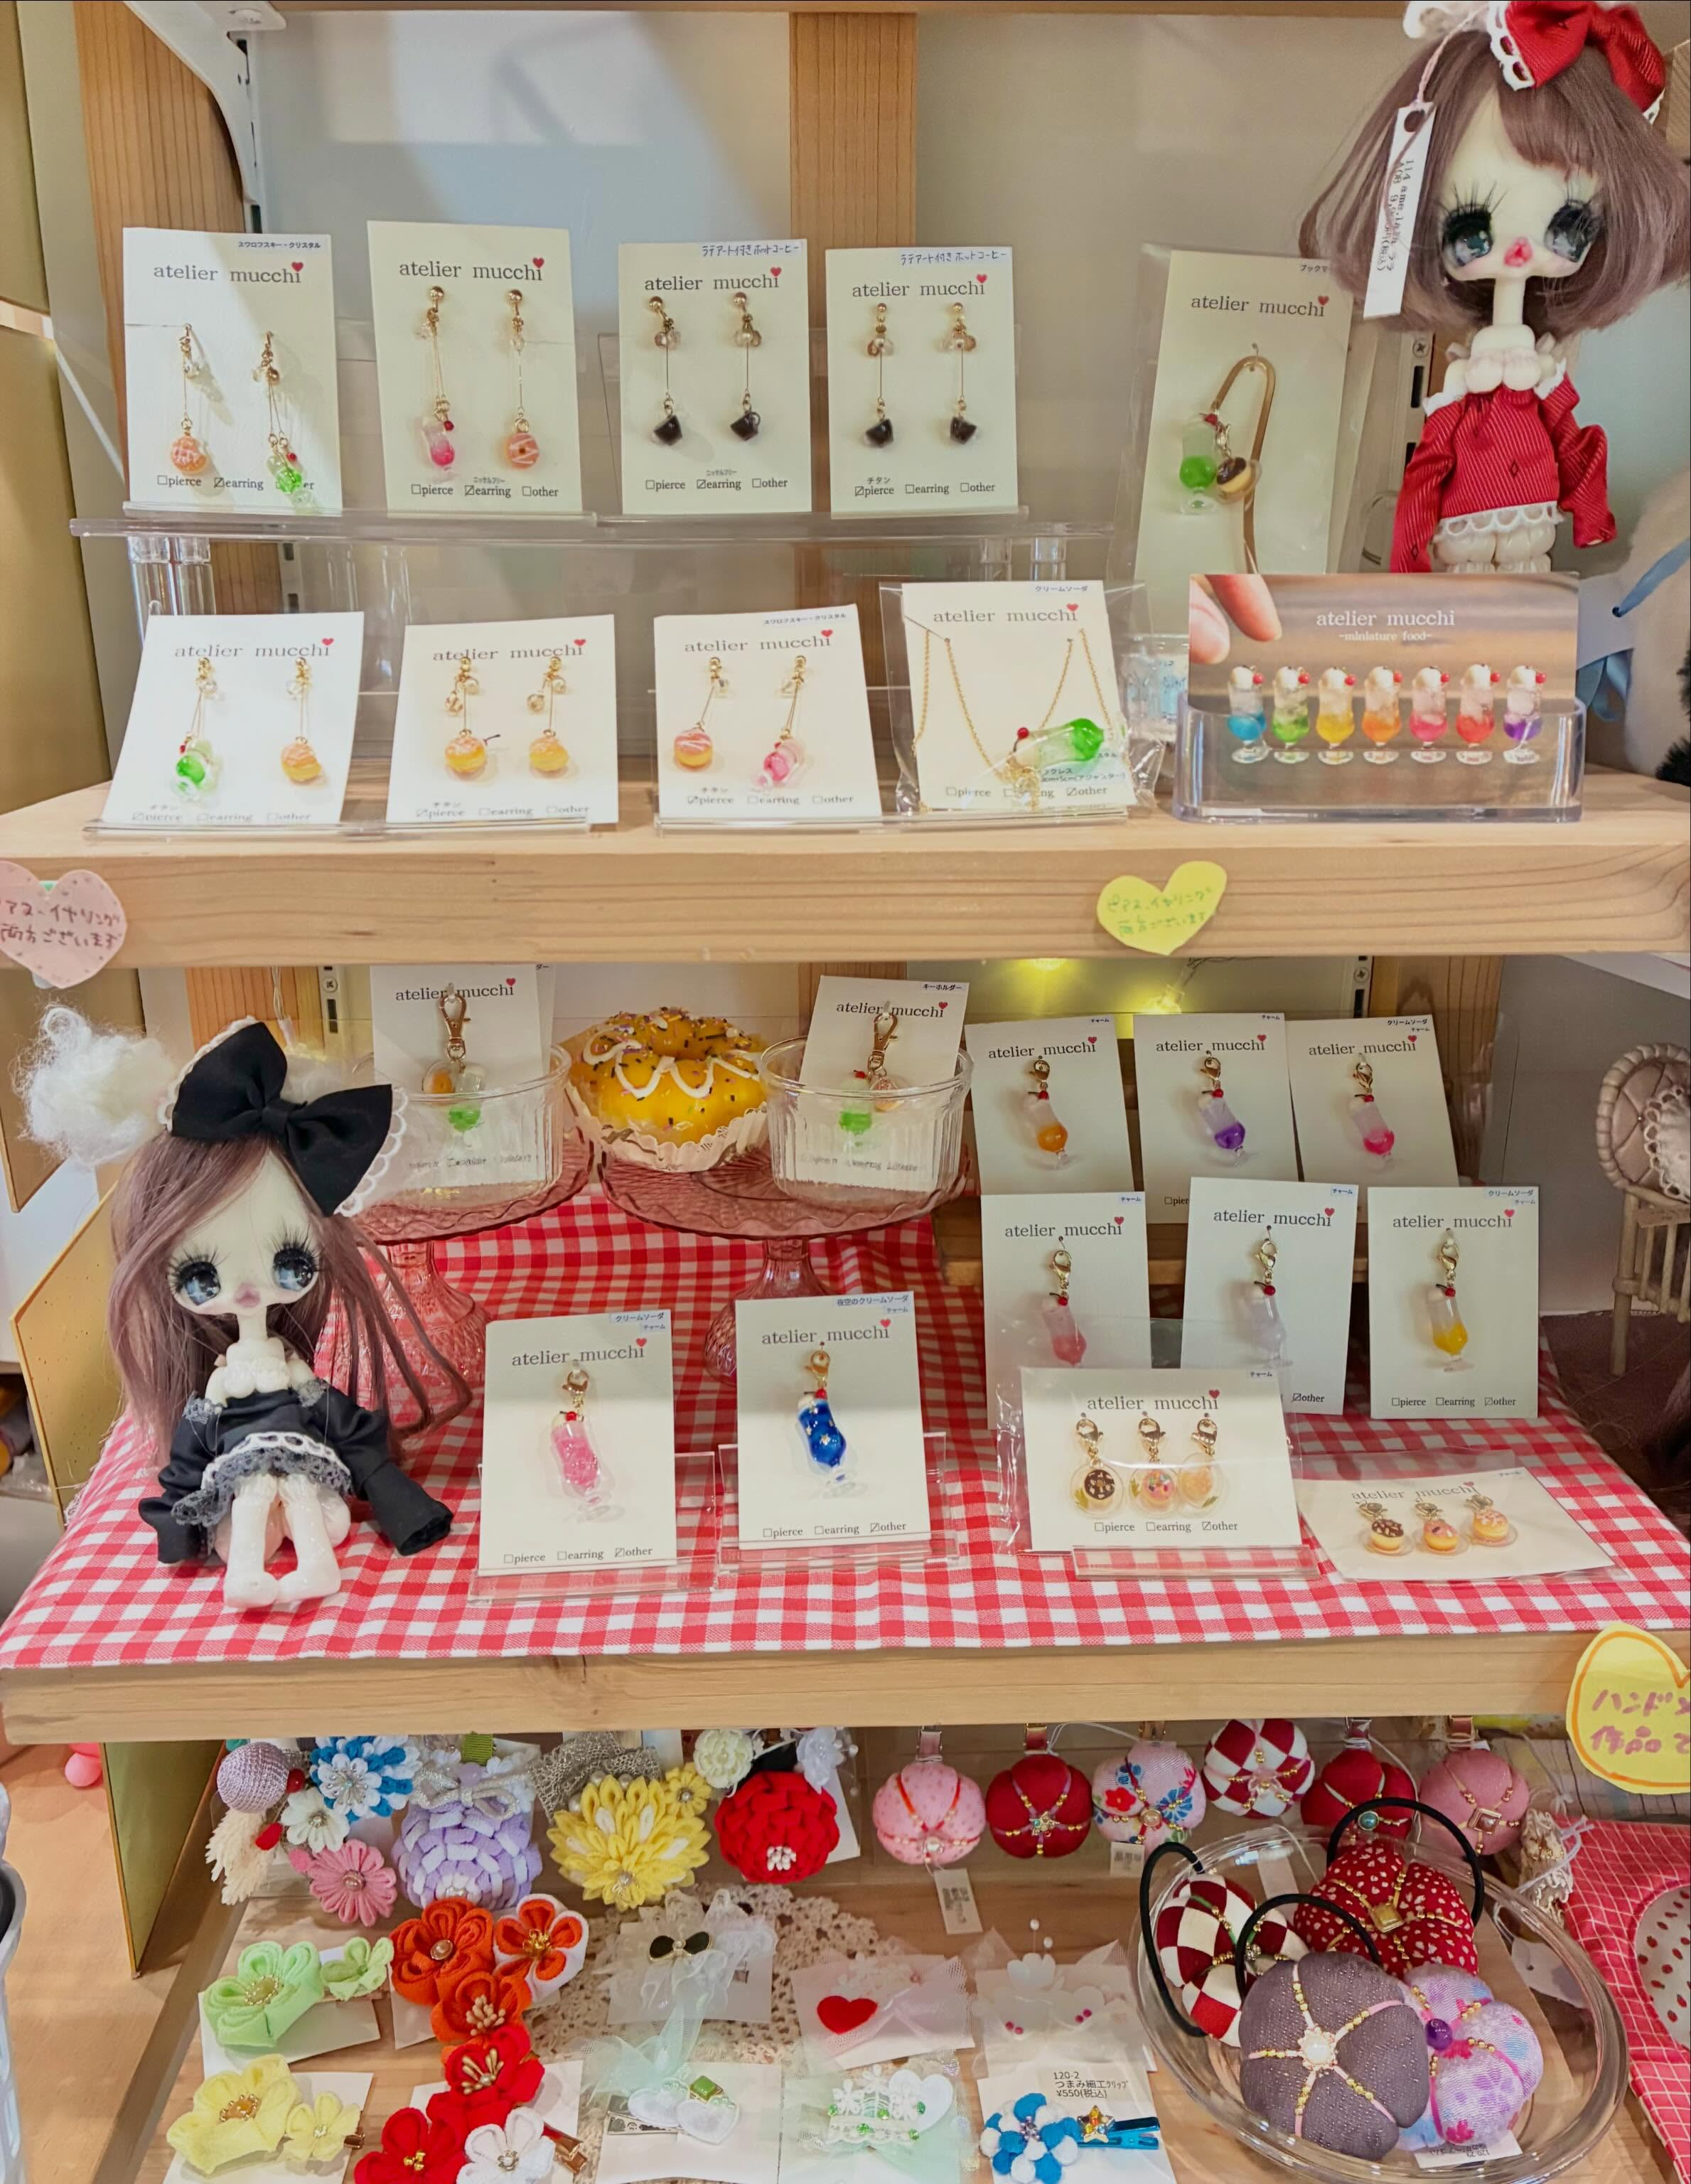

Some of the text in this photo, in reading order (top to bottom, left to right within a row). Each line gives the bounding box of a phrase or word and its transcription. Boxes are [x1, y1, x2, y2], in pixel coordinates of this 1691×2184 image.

[154, 265, 301, 284] atelier mucchi
[399, 261, 542, 281] atelier mucchi
[645, 272, 779, 291] atelier mucchi
[852, 279, 985, 297] atelier mucchi
[1191, 296, 1324, 316] atelier mucchi
[168, 476, 201, 488] pierce
[225, 478, 263, 491] earring
[655, 478, 788, 491] pierce earring other
[864, 482, 995, 497] pierce earring other
[421, 486, 559, 498] pierce earring other
[933, 609, 1078, 622] atelier mucchi
[1316, 610, 1455, 626] atelier mucchi
[175, 644, 330, 657] atelier mucchi
[685, 636, 830, 652] atelier mucchi
[433, 646, 583, 661] atelier mucchi
[1078, 786, 1108, 796] other
[699, 796, 734, 805] pierce
[758, 796, 800, 805] earring
[428, 805, 589, 819] pierce earring other
[837, 1002, 943, 1017] atelier mucchi
[988, 1042, 1096, 1059] atelier mucchi
[1156, 1038, 1265, 1052] atelier mucchi
[1308, 1041, 1416, 1056] atelier mucchi
[1173, 1197, 1189, 1206] pier
[1213, 1208, 1331, 1228] atelier mucchi
[1392, 1214, 1512, 1229] atelier mucchi
[1004, 1220, 1122, 1238] atelier mucchi
[836, 1294, 909, 1307] 夜空のクリームソーダ
[616, 1312, 665, 1323] クリームソーダ
[761, 1325, 889, 1345] atelier mucchi
[512, 1344, 644, 1367] atelier mucchi
[1087, 1393, 1219, 1411] atelier mucchi
[1300, 1393, 1324, 1404] other
[1400, 1396, 1516, 1408] pierce earring other
[1351, 1484, 1478, 1499] atelier mucchi
[773, 1521, 906, 1538] pierce earring other
[1105, 1520, 1238, 1533] pierce earring other
[513, 1546, 653, 1565] pierce earring other
[1056, 2089, 1107, 2098] ¥550(税込)
